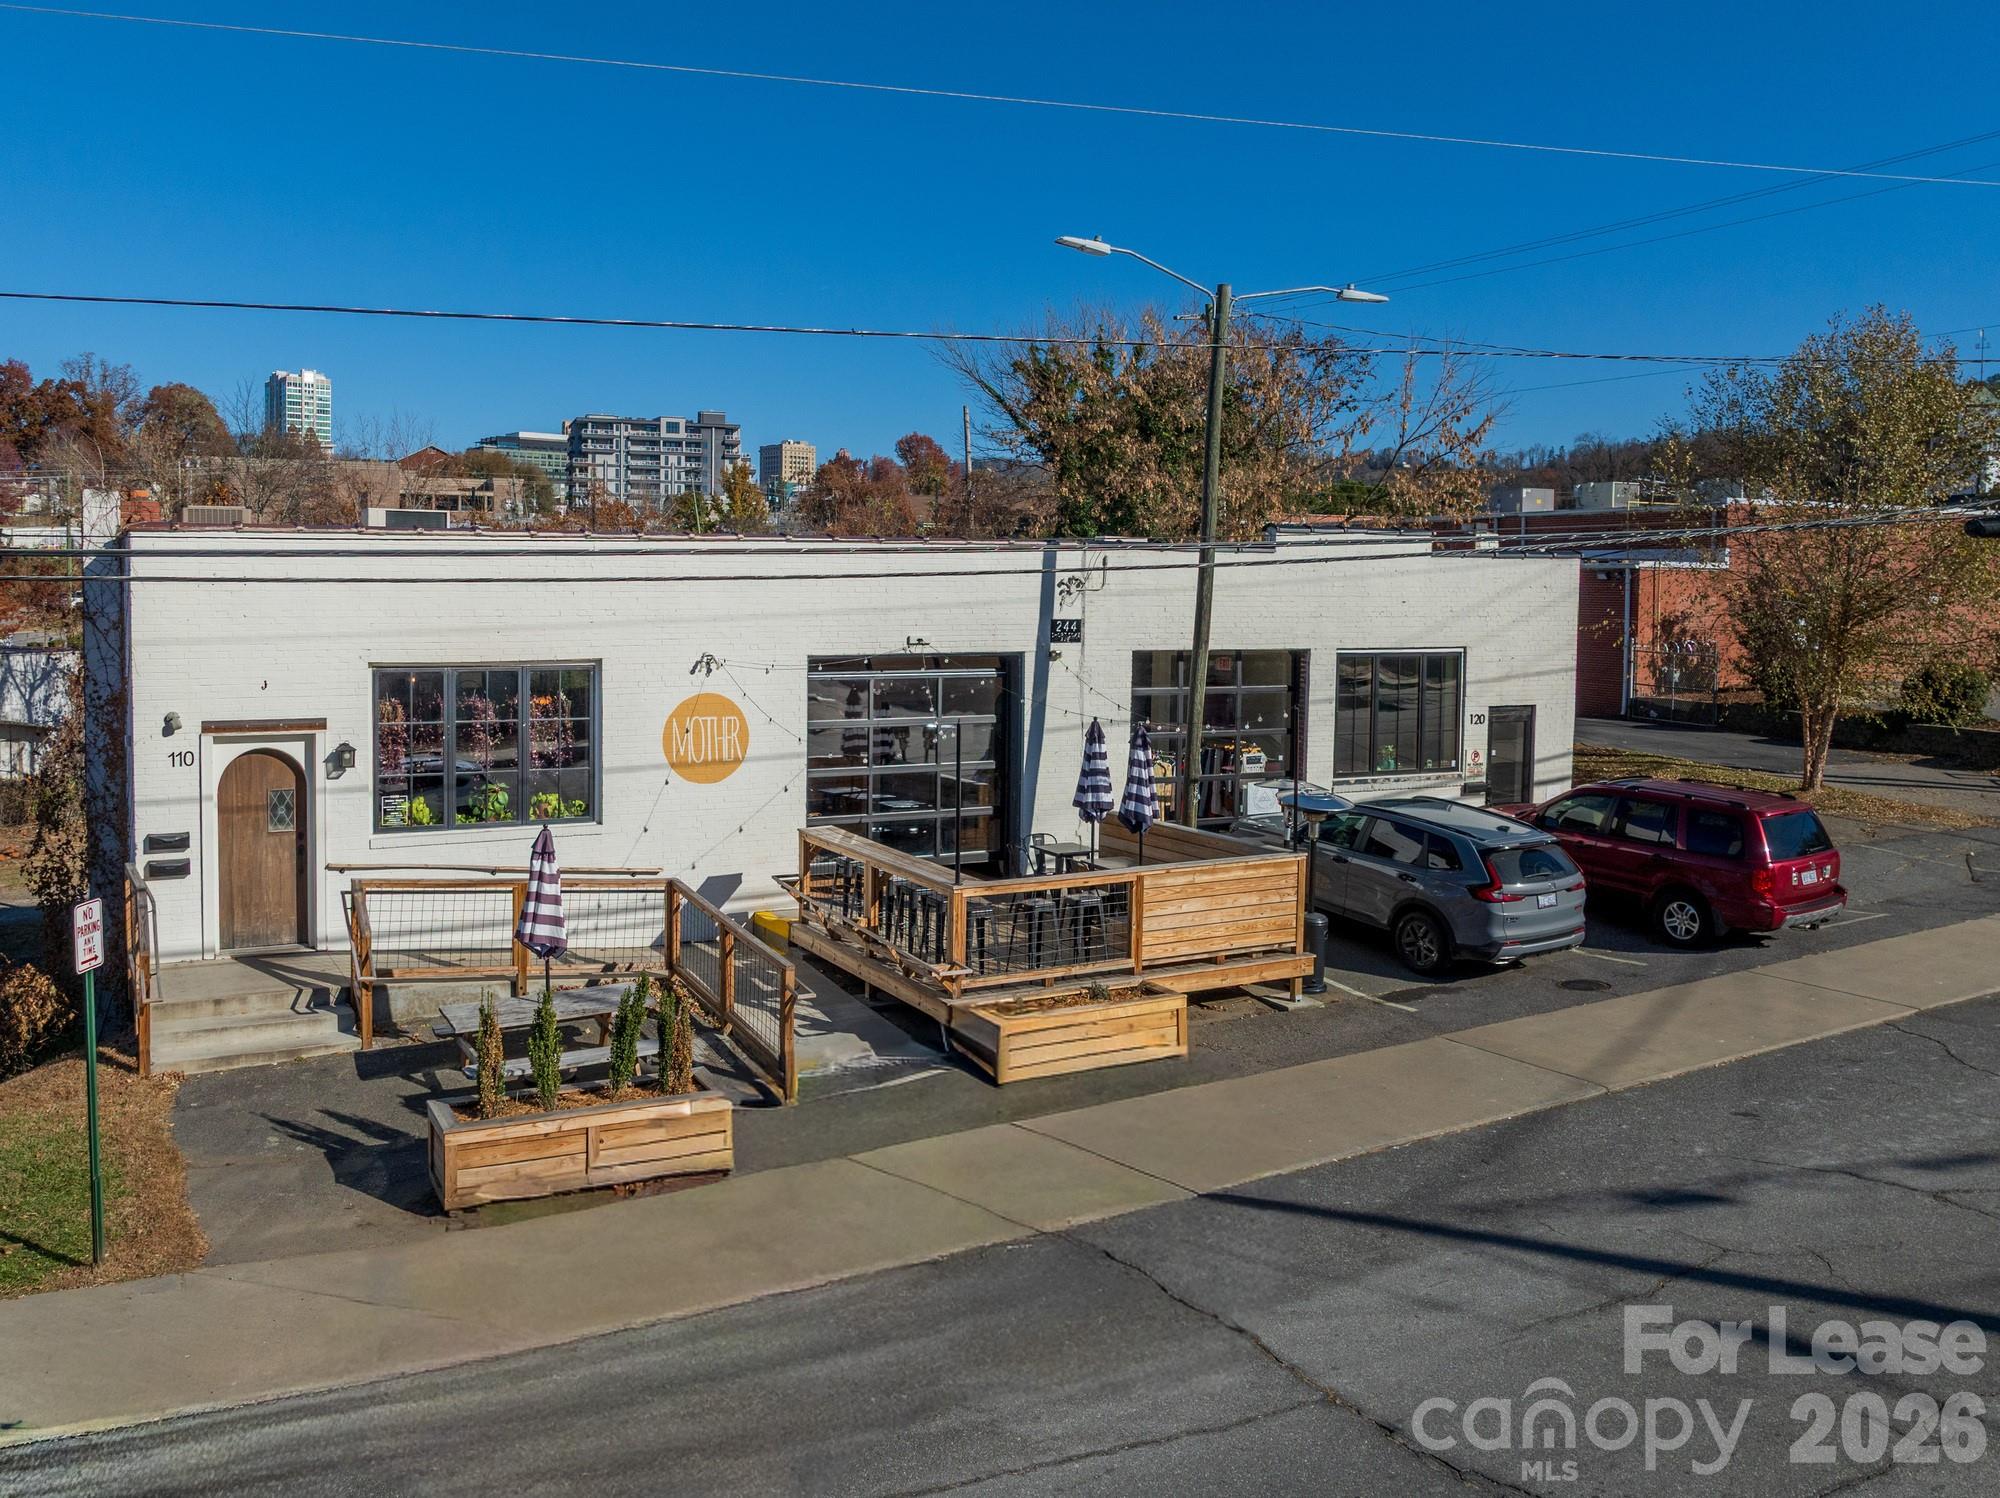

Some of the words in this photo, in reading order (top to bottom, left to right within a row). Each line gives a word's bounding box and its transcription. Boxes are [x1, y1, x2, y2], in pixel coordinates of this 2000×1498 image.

[1056, 620, 1077, 632] 244
[1469, 713, 1486, 725] 120
[672, 716, 743, 764] MOTHER
[167, 750, 195, 768] 110
[82, 907, 94, 922] NO
[77, 919, 101, 938] PARKING
[83, 936, 95, 947] ANY
[82, 944, 96, 958] TIME
